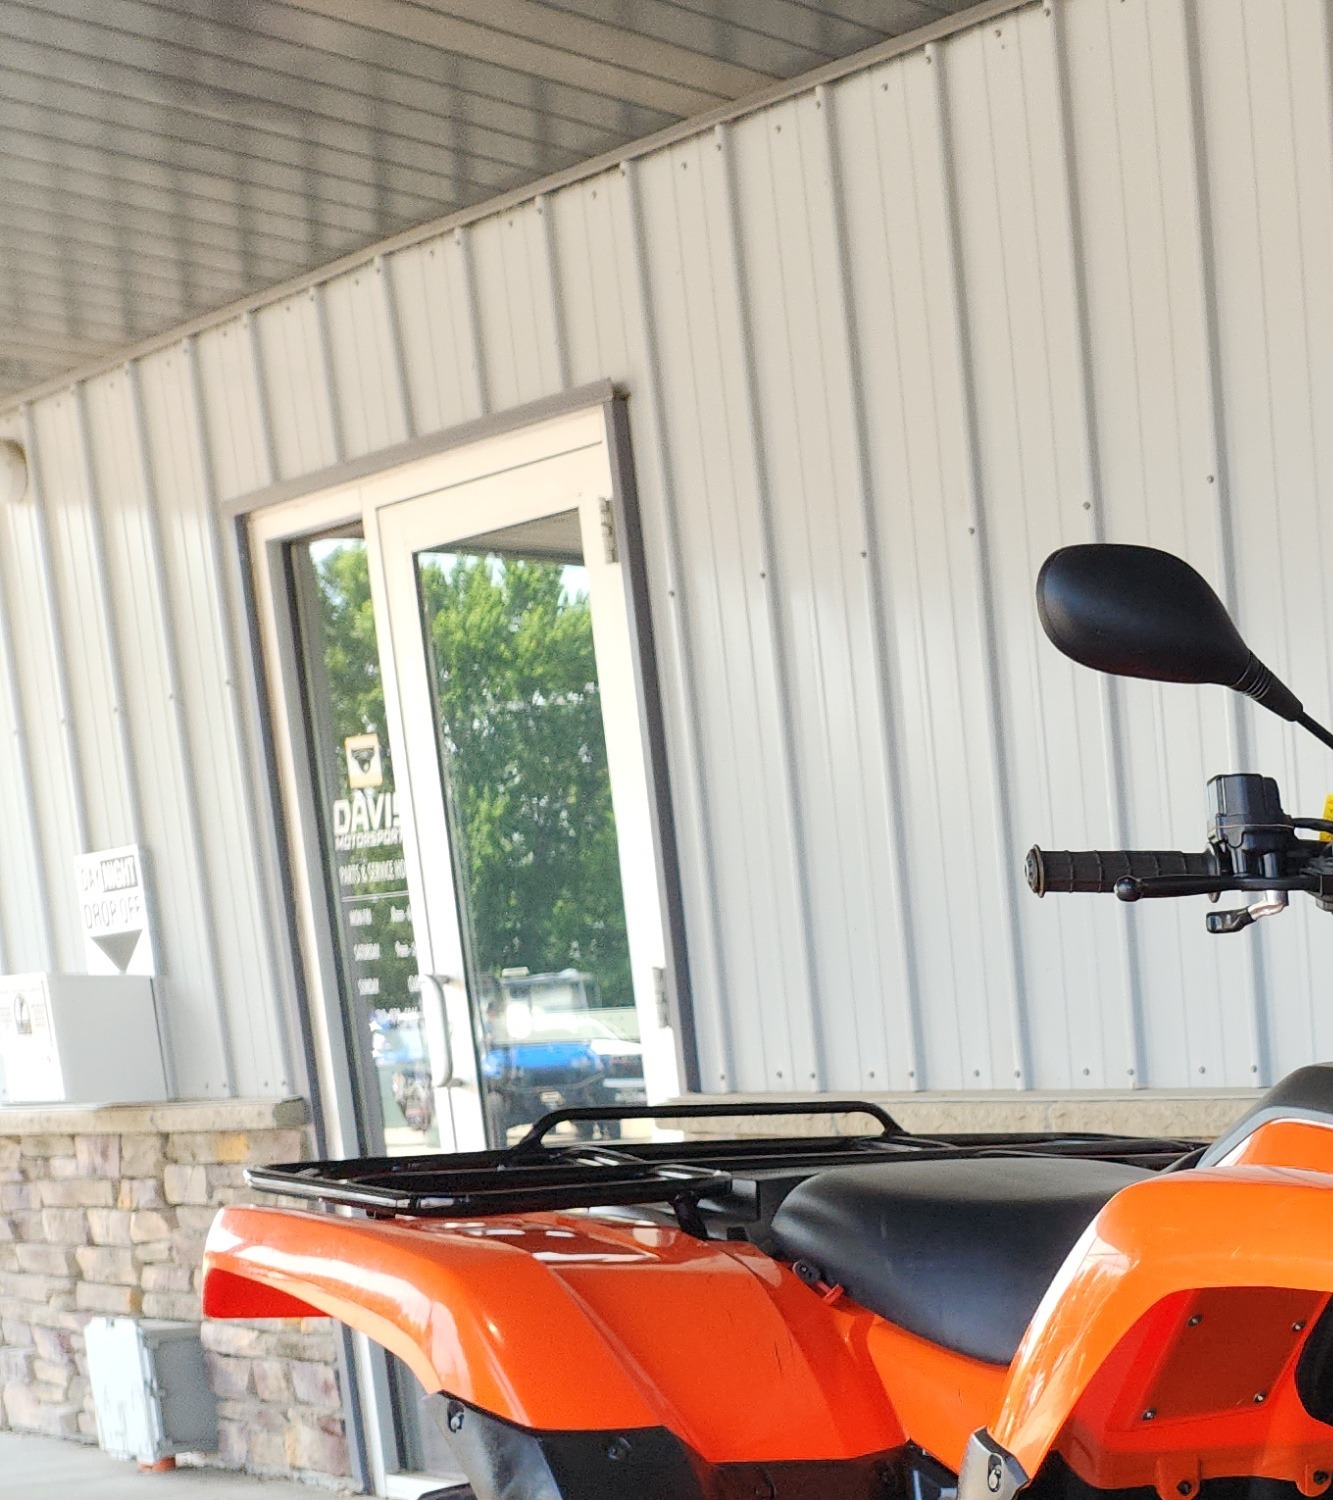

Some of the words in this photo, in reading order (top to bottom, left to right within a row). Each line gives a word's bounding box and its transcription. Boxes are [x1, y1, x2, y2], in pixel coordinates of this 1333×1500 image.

[101, 855, 138, 892] NIGHT
[84, 900, 116, 929] DROP
[119, 895, 140, 924] OFF
